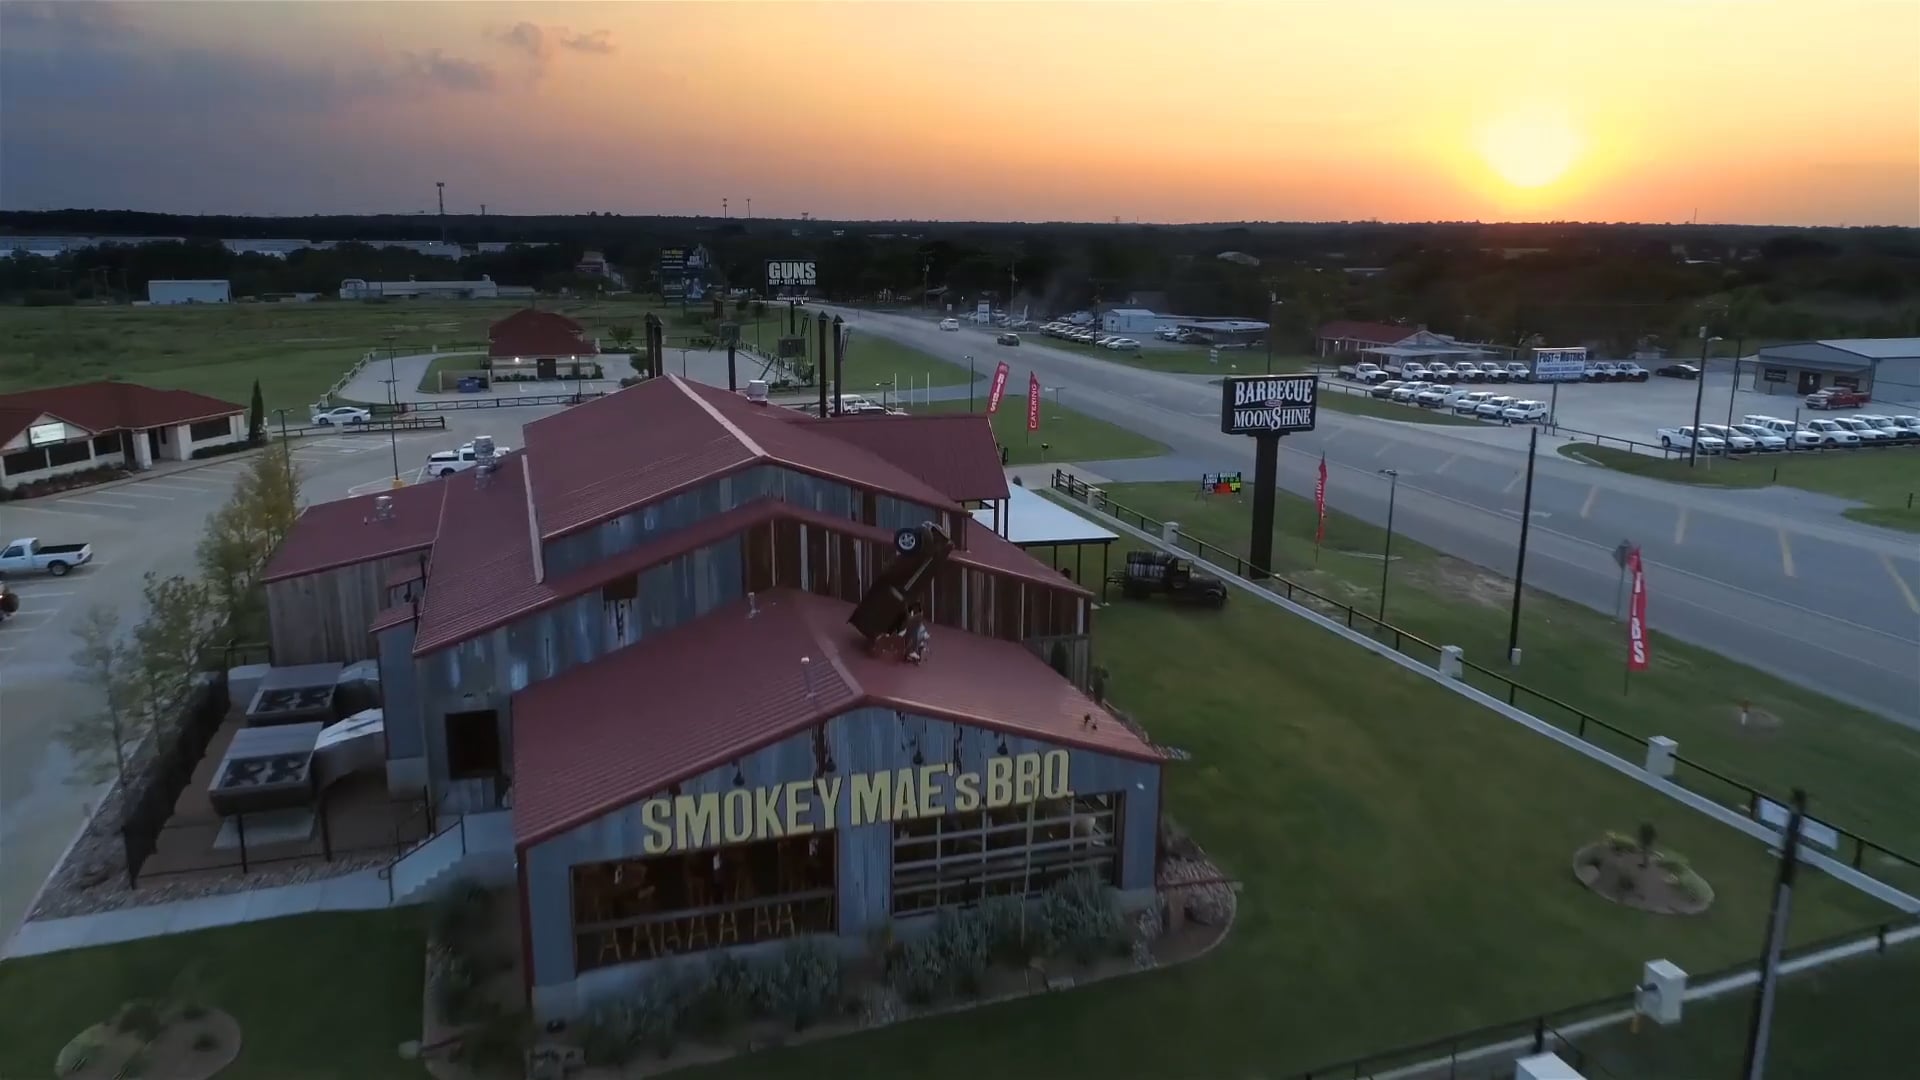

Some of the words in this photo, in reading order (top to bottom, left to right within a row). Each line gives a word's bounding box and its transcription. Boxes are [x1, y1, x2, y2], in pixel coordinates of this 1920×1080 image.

[768, 262, 816, 279] GUNS
[990, 373, 1005, 412] RIBS
[1234, 379, 1314, 406] BARBECUE
[1233, 407, 1311, 431] MOONSHINE
[641, 776, 844, 855] SMOKEY
[849, 762, 981, 827] MAE's
[985, 749, 1075, 809] BBQ
